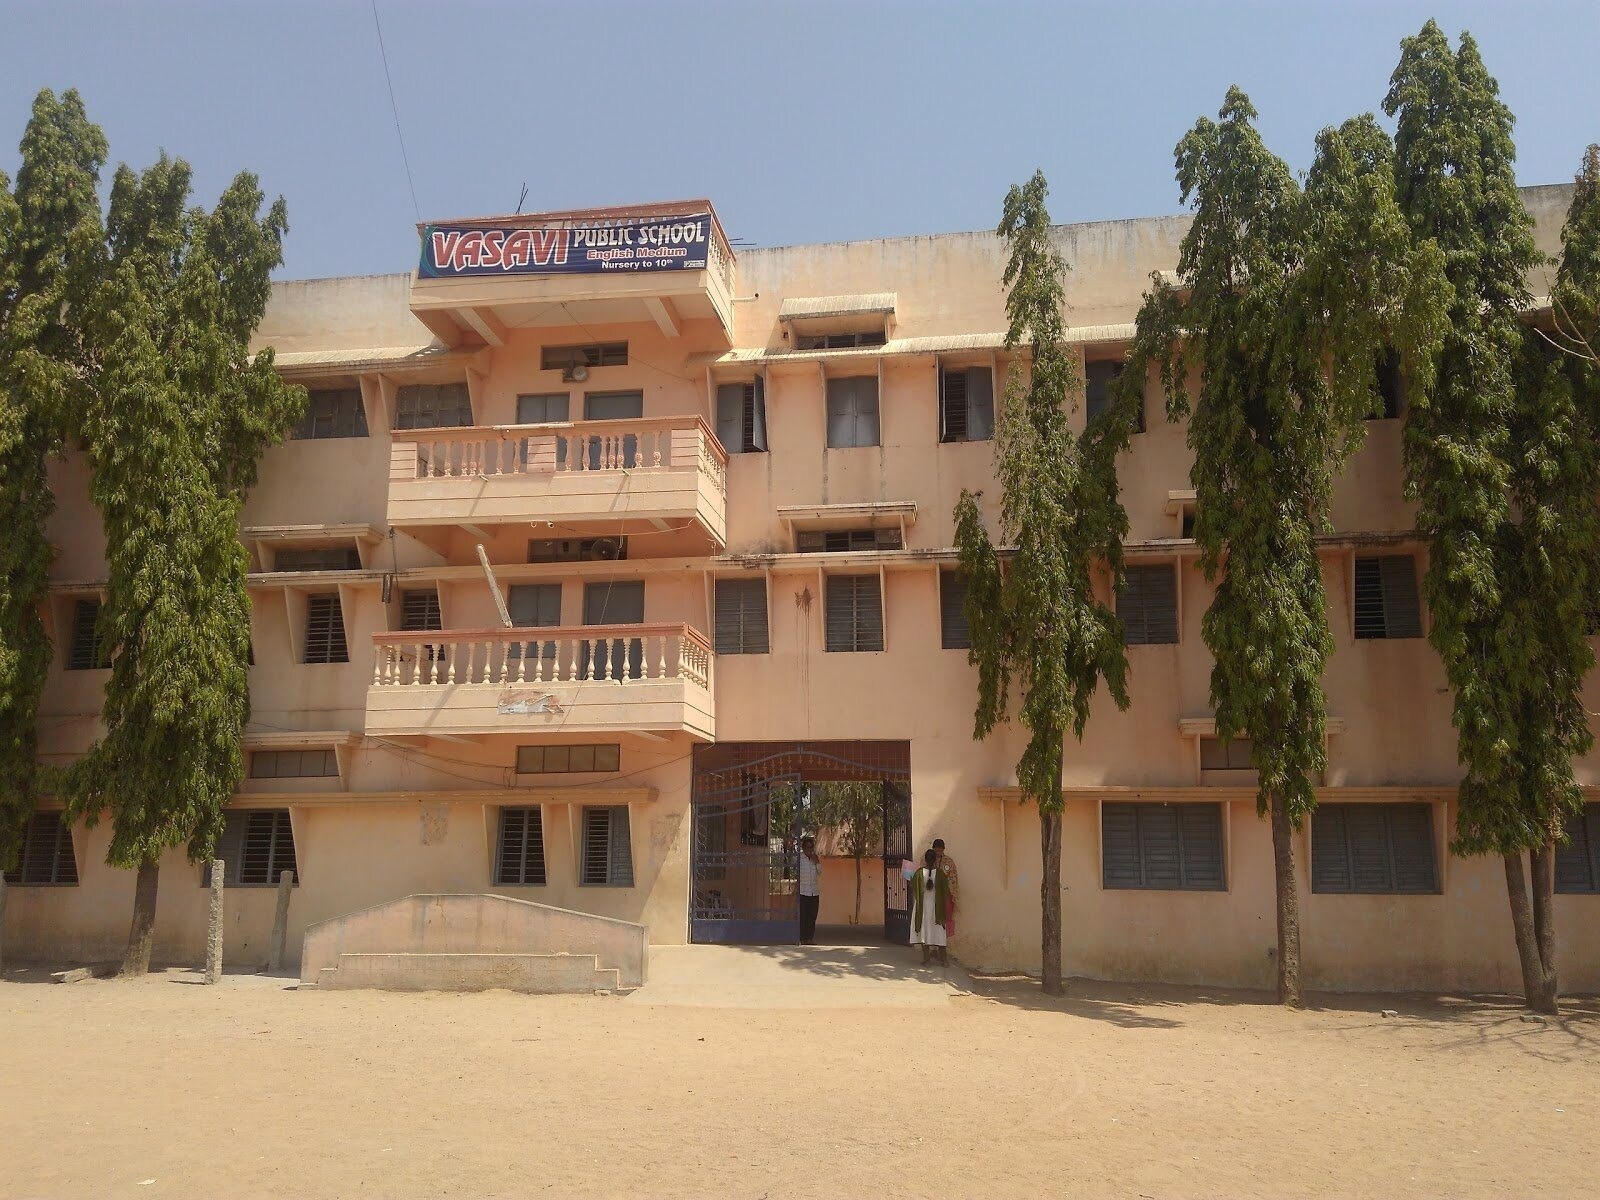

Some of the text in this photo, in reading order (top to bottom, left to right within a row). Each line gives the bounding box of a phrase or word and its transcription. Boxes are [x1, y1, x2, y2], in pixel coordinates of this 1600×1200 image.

[432, 222, 705, 271] VASAVI PUBLIC SCHOOL
[586, 247, 687, 260] English Medium
[601, 261, 639, 270] Nursery
[643, 259, 652, 268] to
[655, 258, 673, 267] 10th
